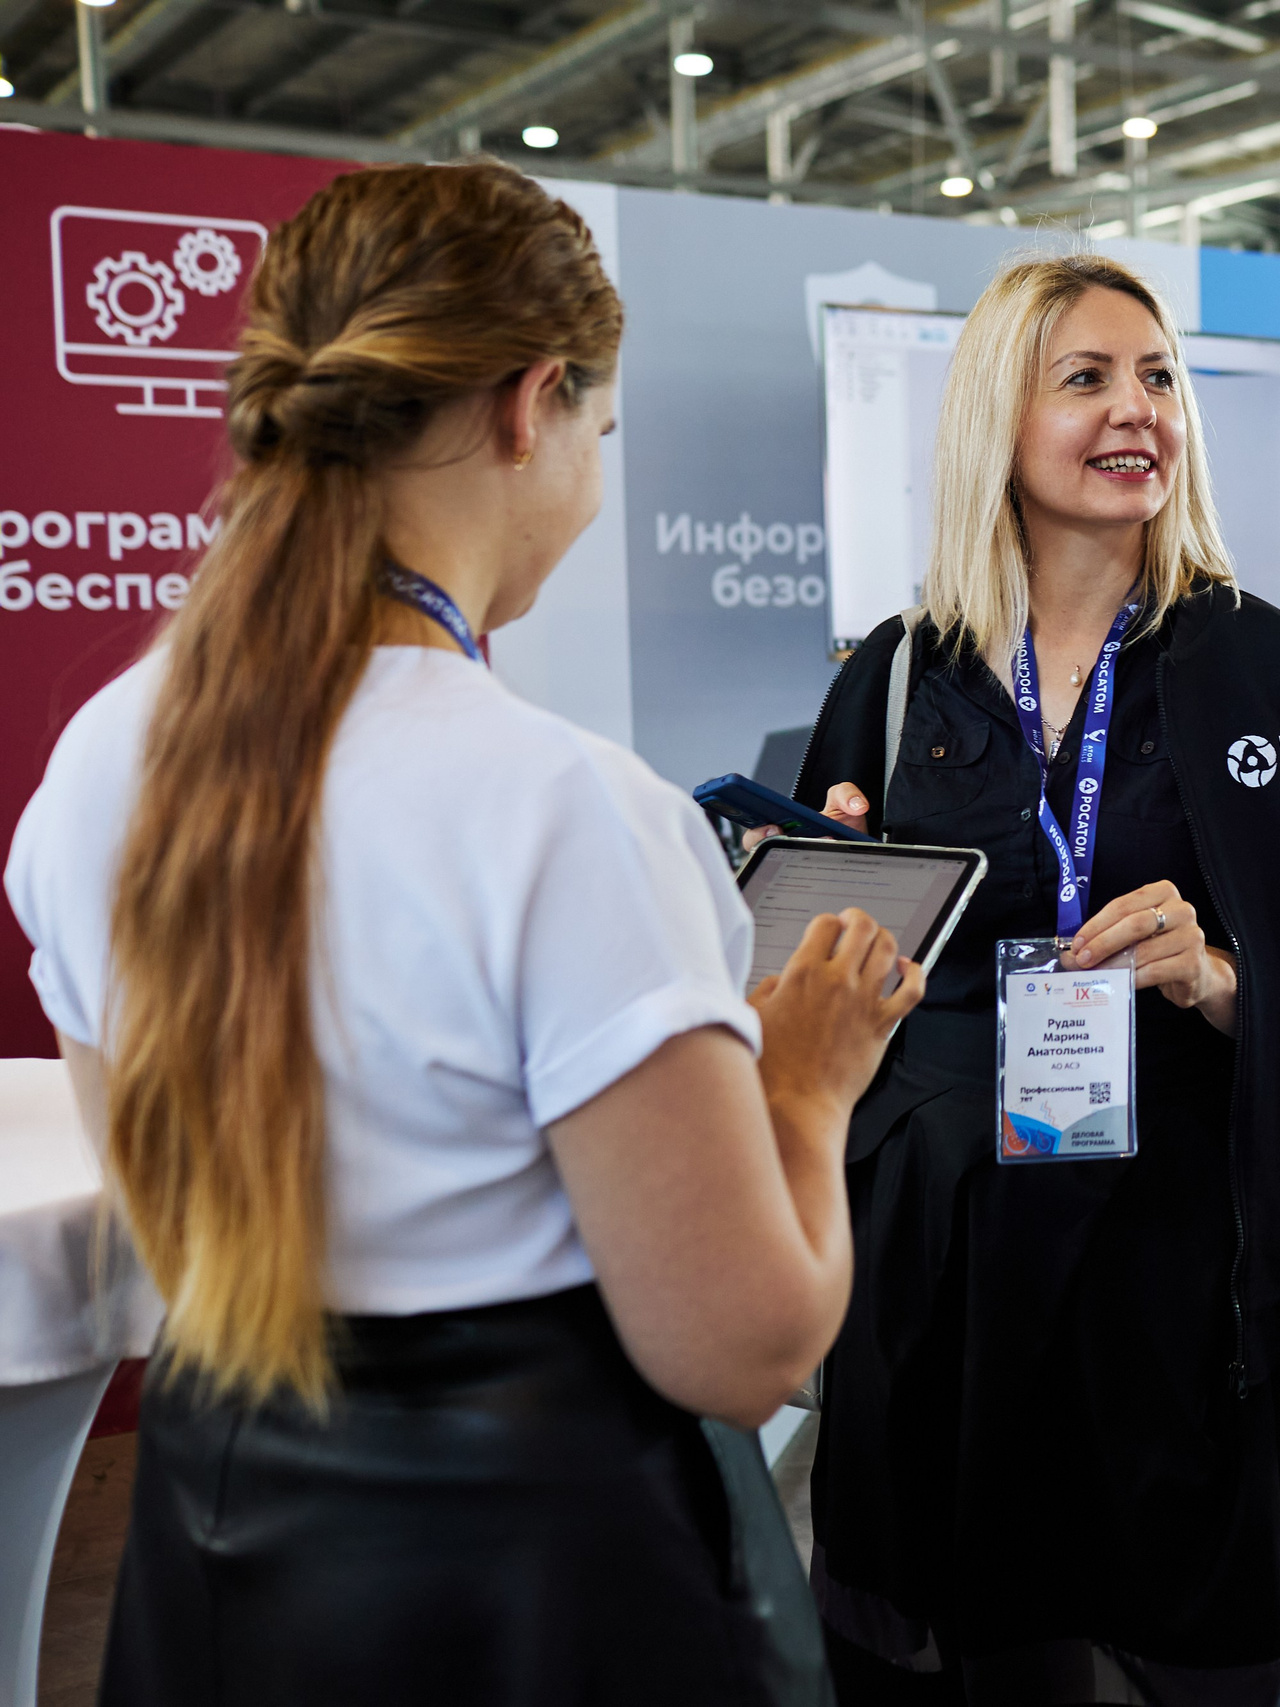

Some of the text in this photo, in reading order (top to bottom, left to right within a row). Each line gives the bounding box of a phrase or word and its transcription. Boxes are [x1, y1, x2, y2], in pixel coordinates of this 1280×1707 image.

[656, 511, 825, 565] Инфор
[711, 563, 826, 608] безо
[1093, 653, 1112, 714] РОСАТОМ
[1074, 796, 1093, 858] РОСАТОМ
[1049, 824, 1071, 885] РОСАТОМ
[1075, 988, 1090, 1000] IX
[1047, 1019, 1085, 1030] Рудаш
[1043, 1032, 1089, 1043] Марина
[1027, 1046, 1104, 1057] Анатольевна
[1020, 1086, 1084, 1095] Профессионали
[1071, 1131, 1104, 1139] ДЕЛОВАЯ
[1071, 1139, 1115, 1147] ПРОГРАММА
